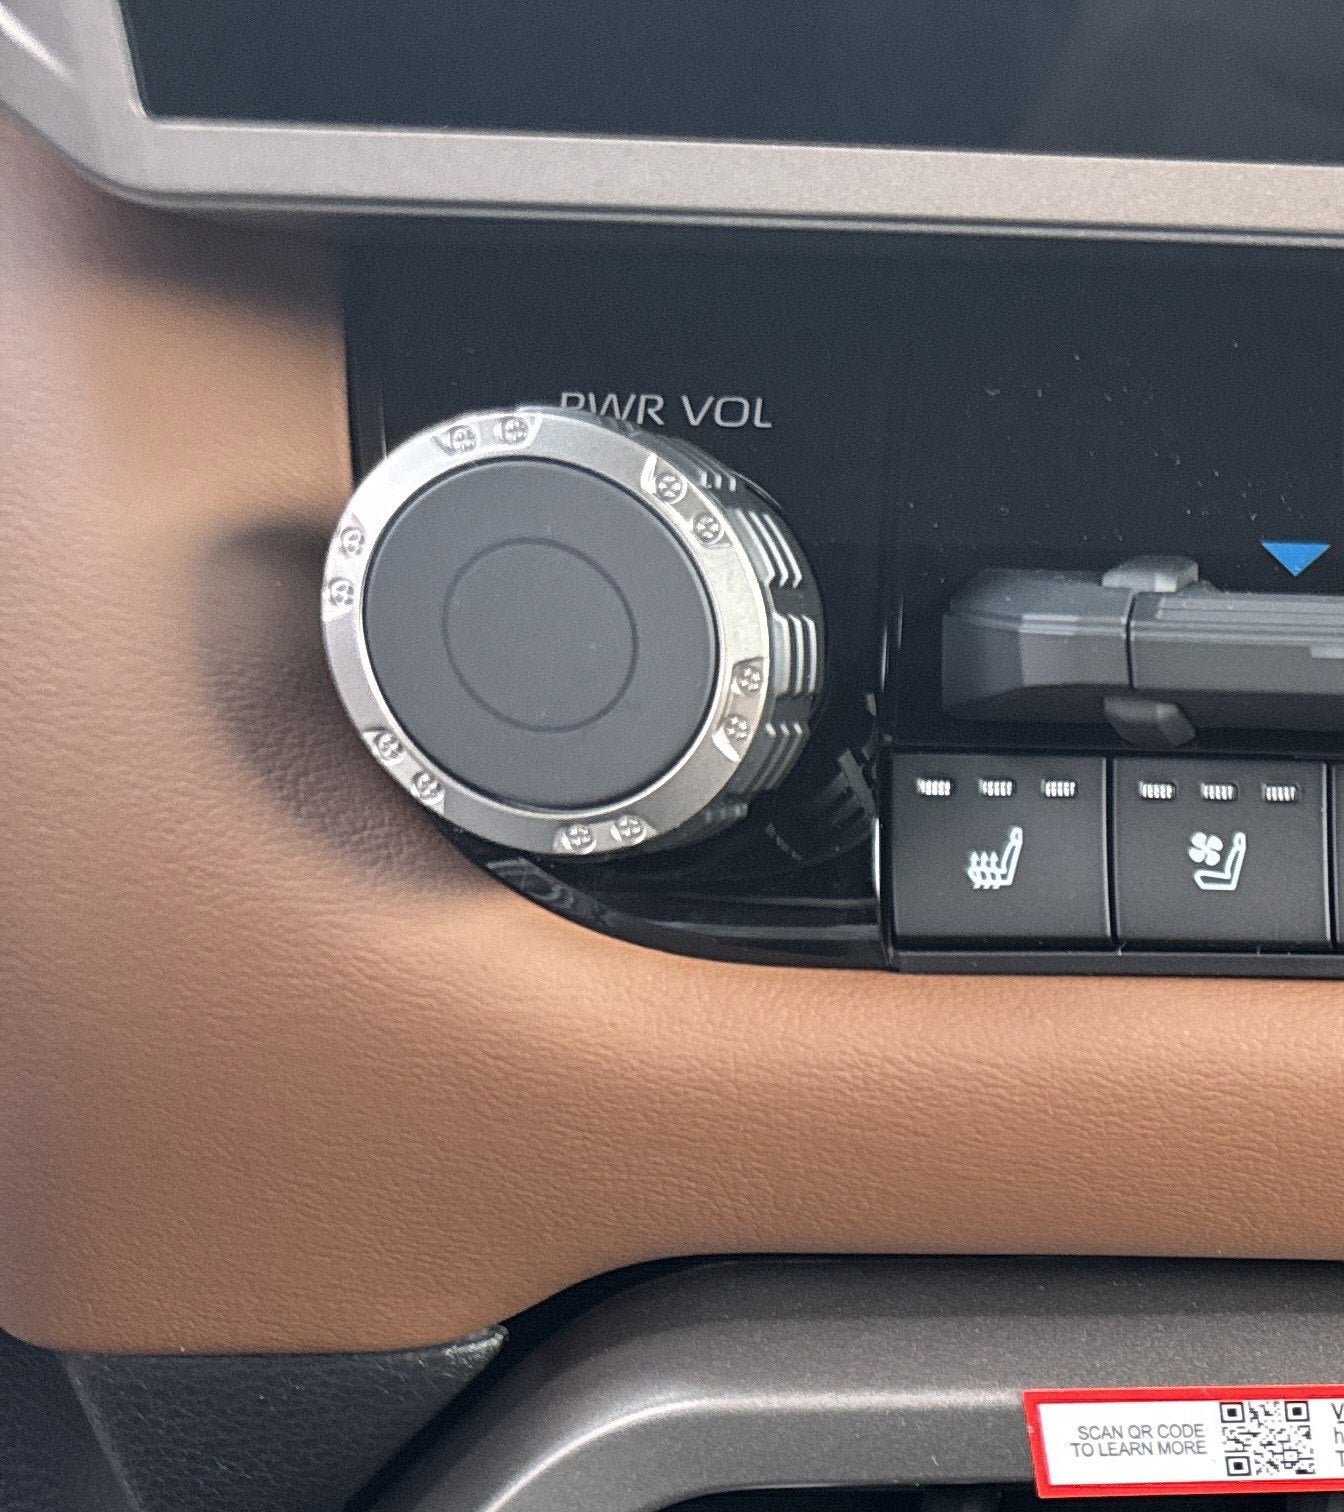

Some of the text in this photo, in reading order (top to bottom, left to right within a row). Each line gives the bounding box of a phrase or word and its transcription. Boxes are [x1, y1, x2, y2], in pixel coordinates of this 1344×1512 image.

[681, 394, 773, 428] VOL
[1077, 1423, 1206, 1440] SCAN QR CODE
[1070, 1440, 1208, 1457] TO LEARN MORE
